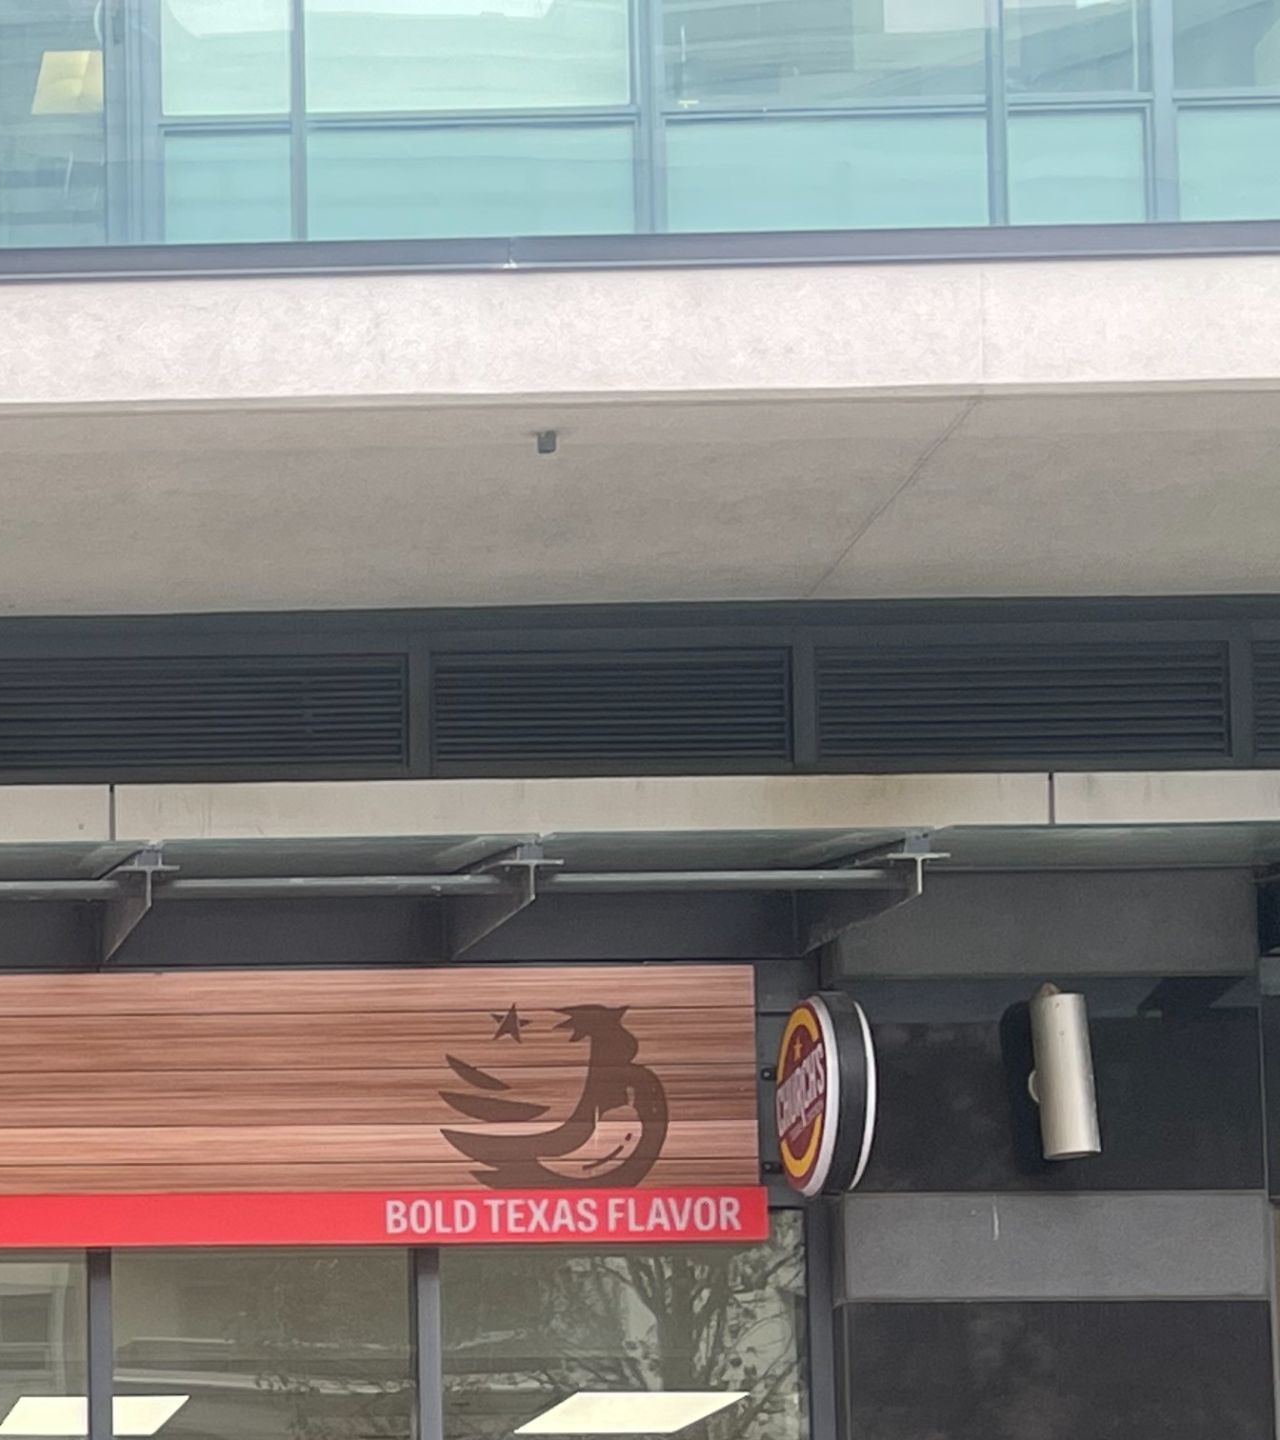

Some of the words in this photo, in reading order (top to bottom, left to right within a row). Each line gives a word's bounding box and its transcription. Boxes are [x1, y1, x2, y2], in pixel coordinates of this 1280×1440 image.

[386, 1199, 477, 1234] BOLD
[484, 1198, 597, 1233] TEXAS
[607, 1197, 742, 1232] FLAVOR
